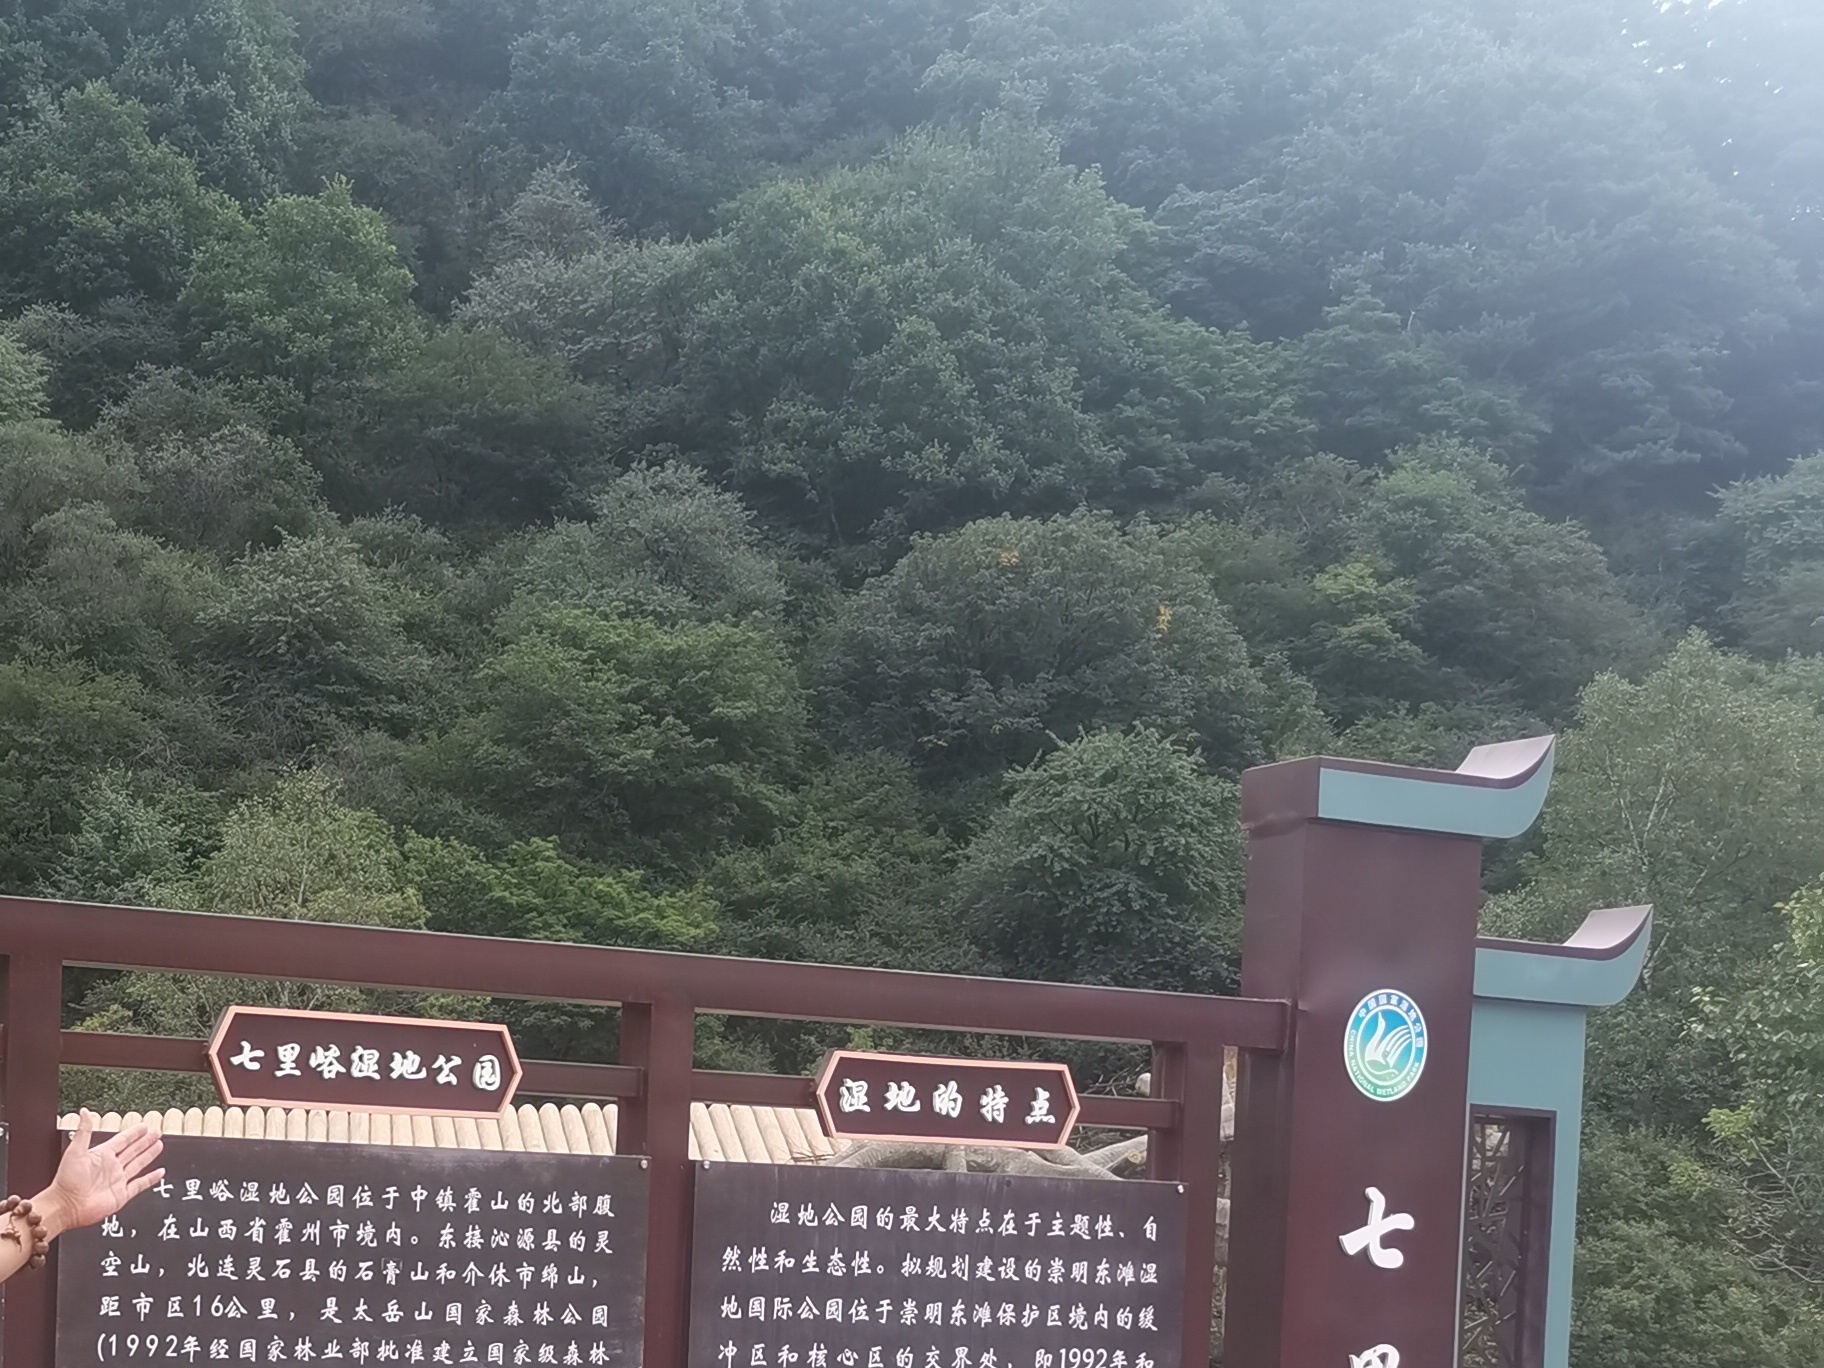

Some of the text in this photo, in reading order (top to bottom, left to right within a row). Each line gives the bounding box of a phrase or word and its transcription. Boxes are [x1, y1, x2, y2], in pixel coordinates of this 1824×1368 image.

[230, 1041, 501, 1091] 七里峪湿地公园
[838, 1078, 1056, 1124] 湿地的特点
